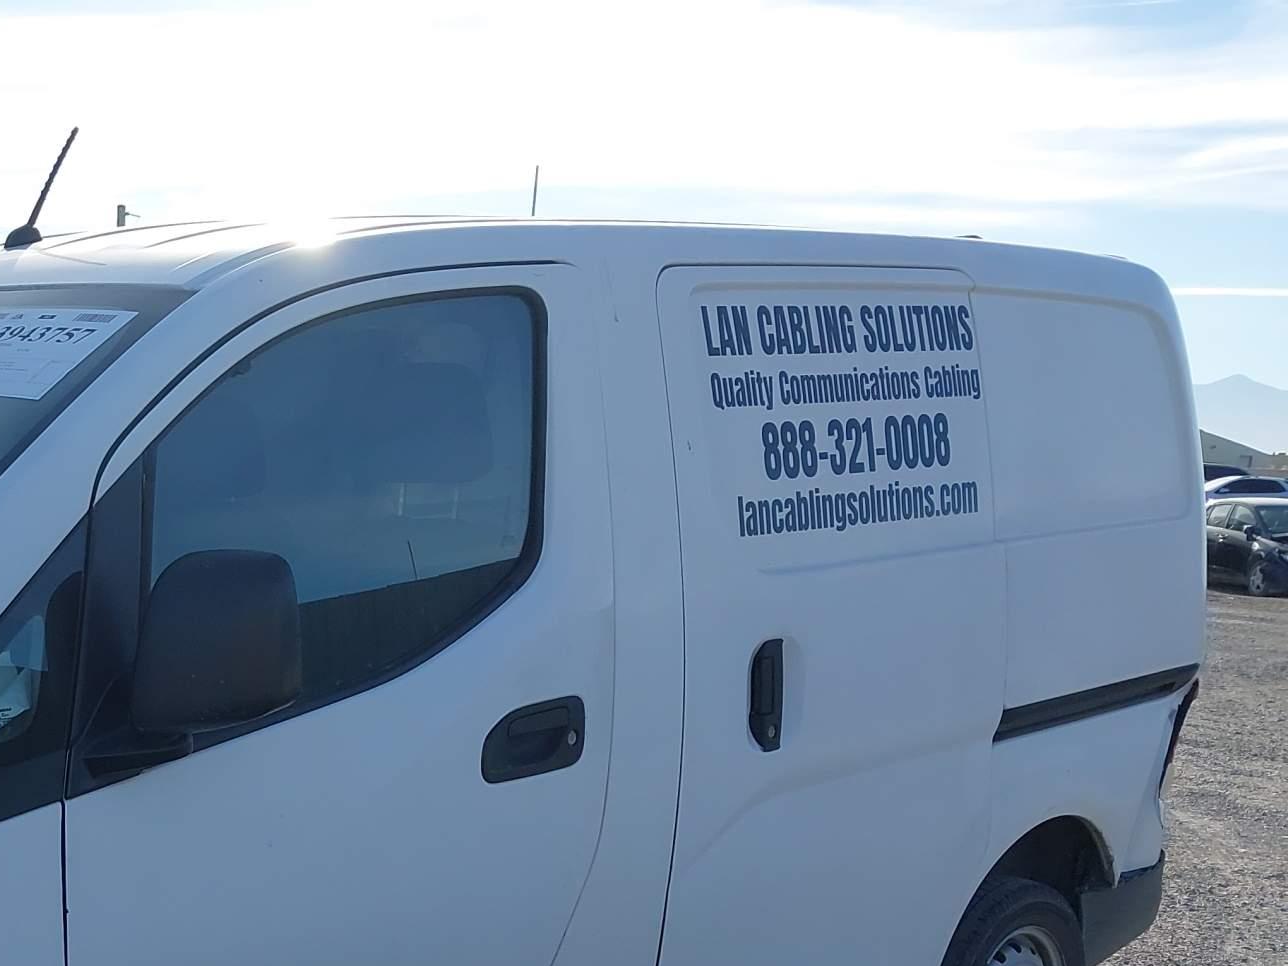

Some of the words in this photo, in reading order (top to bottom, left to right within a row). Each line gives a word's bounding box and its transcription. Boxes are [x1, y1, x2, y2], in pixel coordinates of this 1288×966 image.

[700, 305, 753, 356] LAN
[757, 305, 857, 355] CABLING
[860, 304, 974, 353] SOLUTIONS
[711, 370, 774, 410] Quality
[778, 365, 921, 405] Communications
[924, 363, 981, 400] Cabling
[762, 413, 951, 480] 888-321-0008
[737, 481, 979, 537] lancablingsolutions.com
